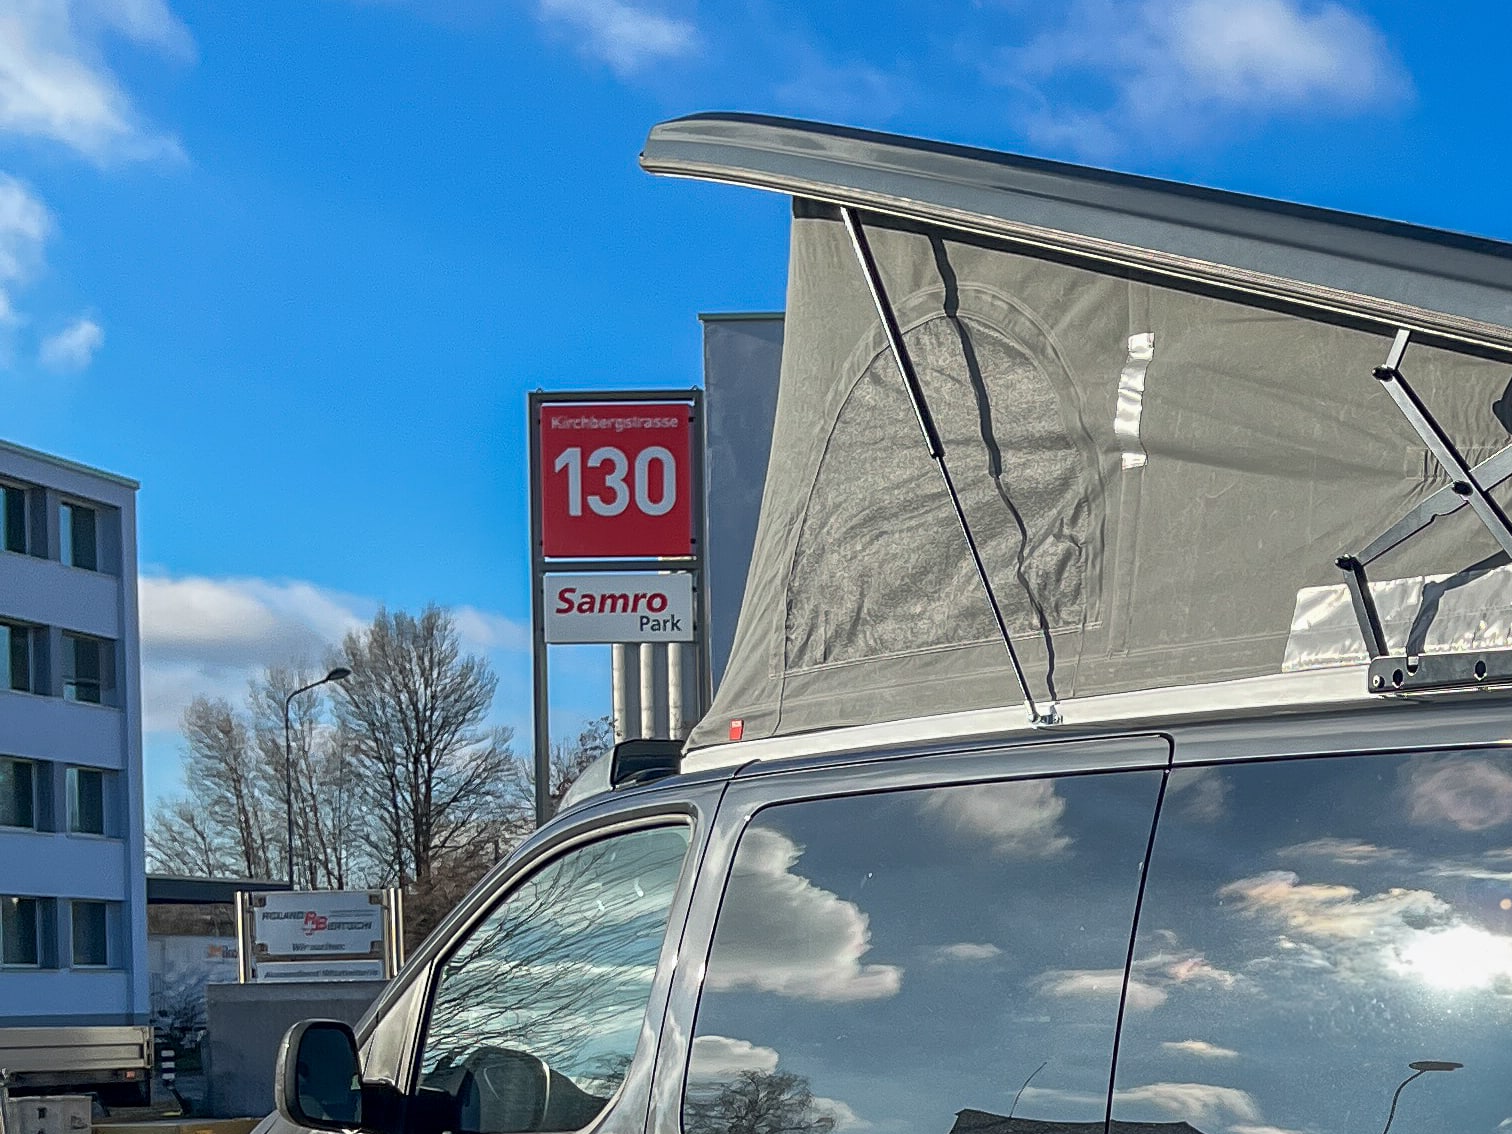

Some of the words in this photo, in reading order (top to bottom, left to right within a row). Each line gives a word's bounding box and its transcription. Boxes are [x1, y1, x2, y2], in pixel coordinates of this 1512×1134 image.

[551, 416, 679, 432] Kirchbergstrasse
[554, 446, 677, 517] 130
[555, 587, 668, 615] Samro
[639, 614, 682, 632] Park
